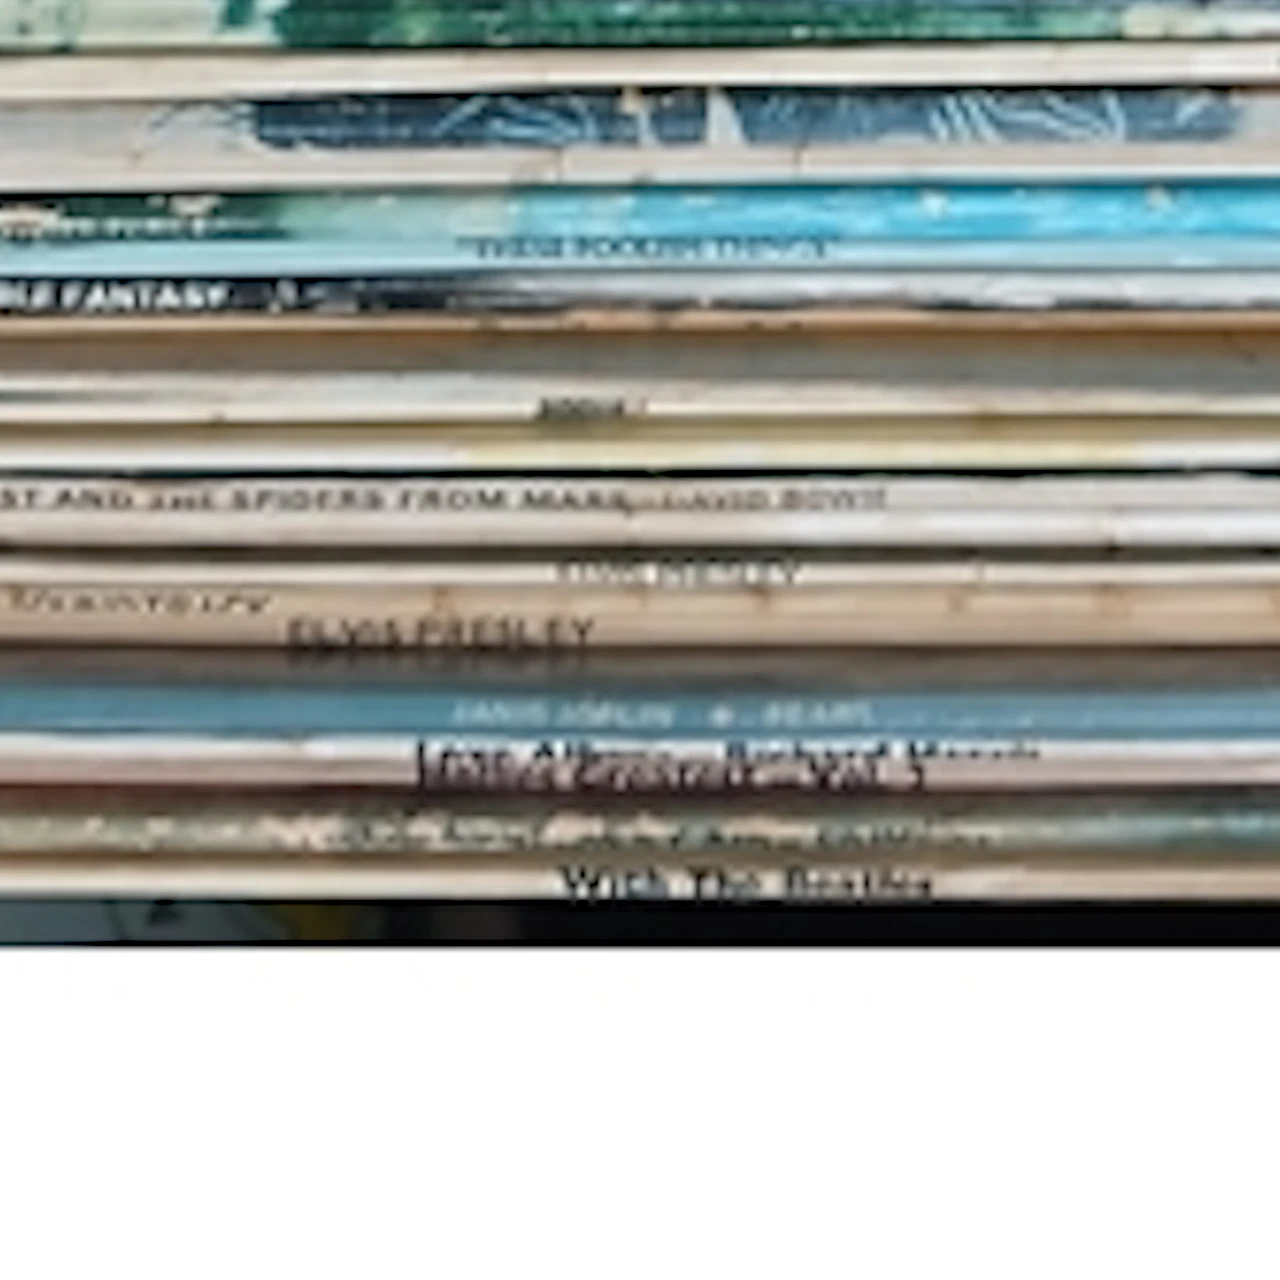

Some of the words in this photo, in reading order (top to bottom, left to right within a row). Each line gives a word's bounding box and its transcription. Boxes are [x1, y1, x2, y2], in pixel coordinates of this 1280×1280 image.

[58, 486, 133, 511] AND
[400, 486, 513, 512] FROM
[562, 867, 667, 900] With
